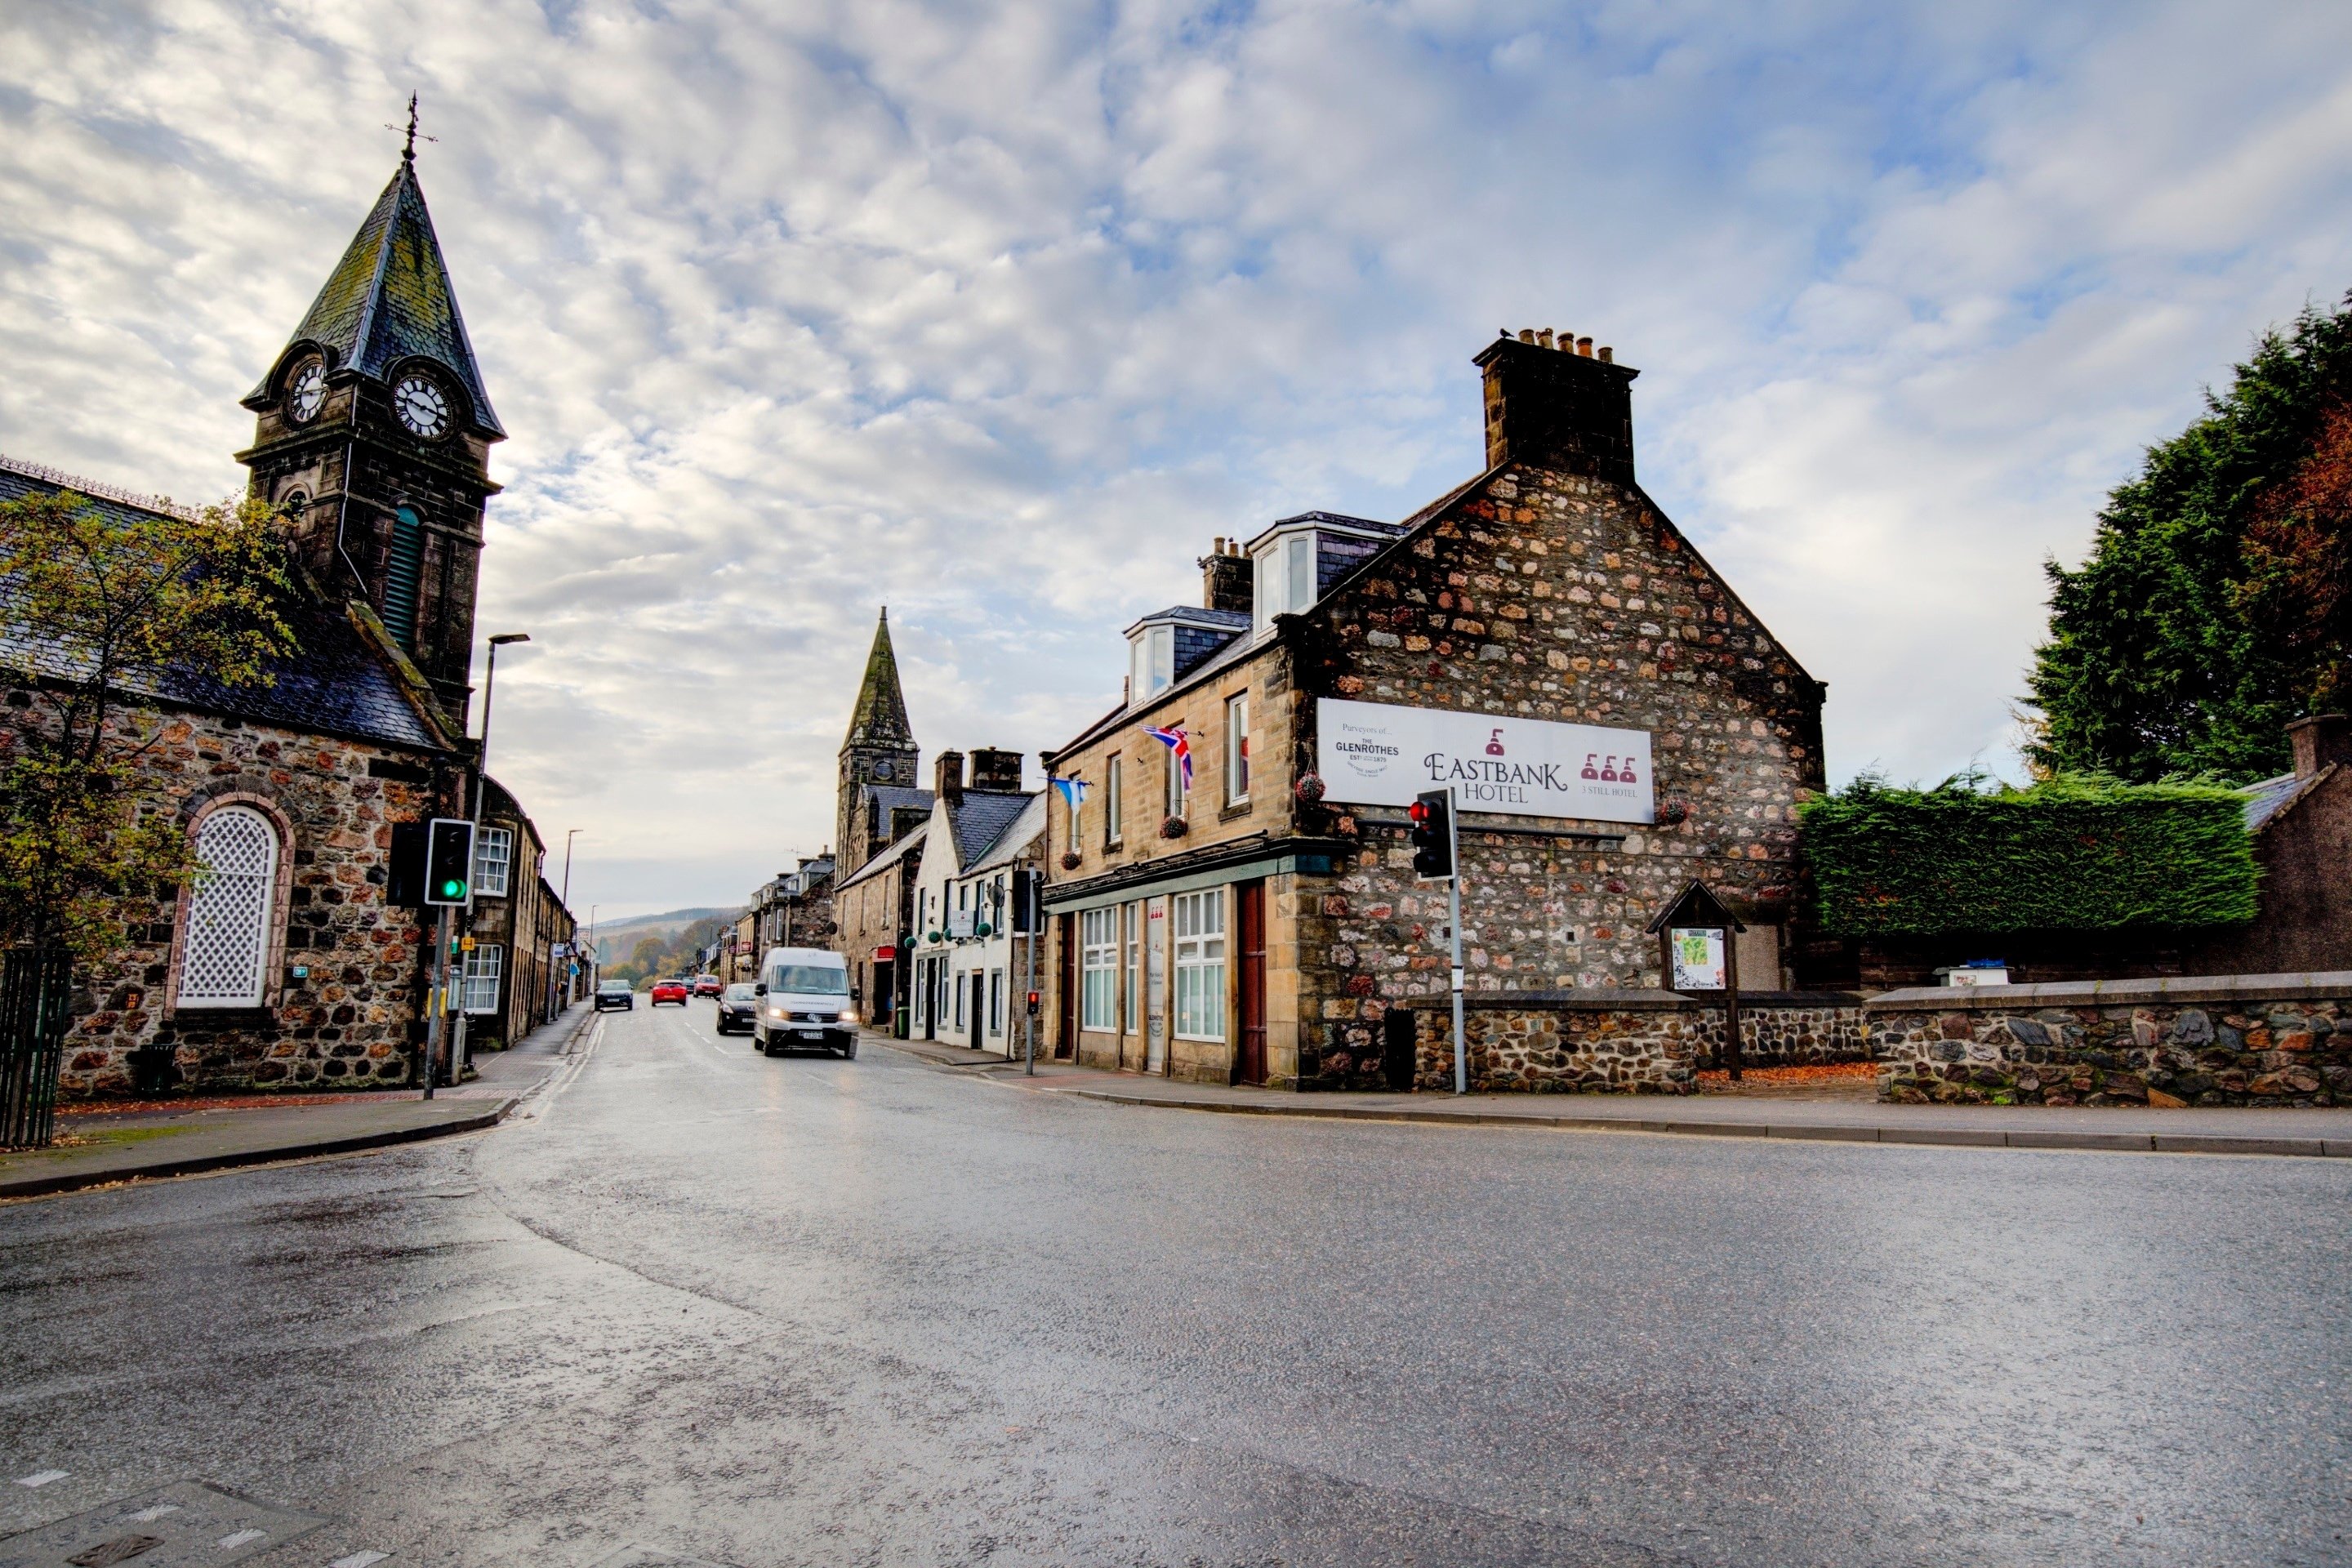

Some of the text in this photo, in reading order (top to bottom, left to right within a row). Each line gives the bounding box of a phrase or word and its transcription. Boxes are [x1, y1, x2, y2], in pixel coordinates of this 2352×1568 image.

[1343, 723, 1378, 735] Purveyors
[1336, 742, 1399, 756] GLENROTHES
[1464, 782, 1529, 804] HOTEL
[1581, 785, 1638, 798] 3 STILL HOTEL
